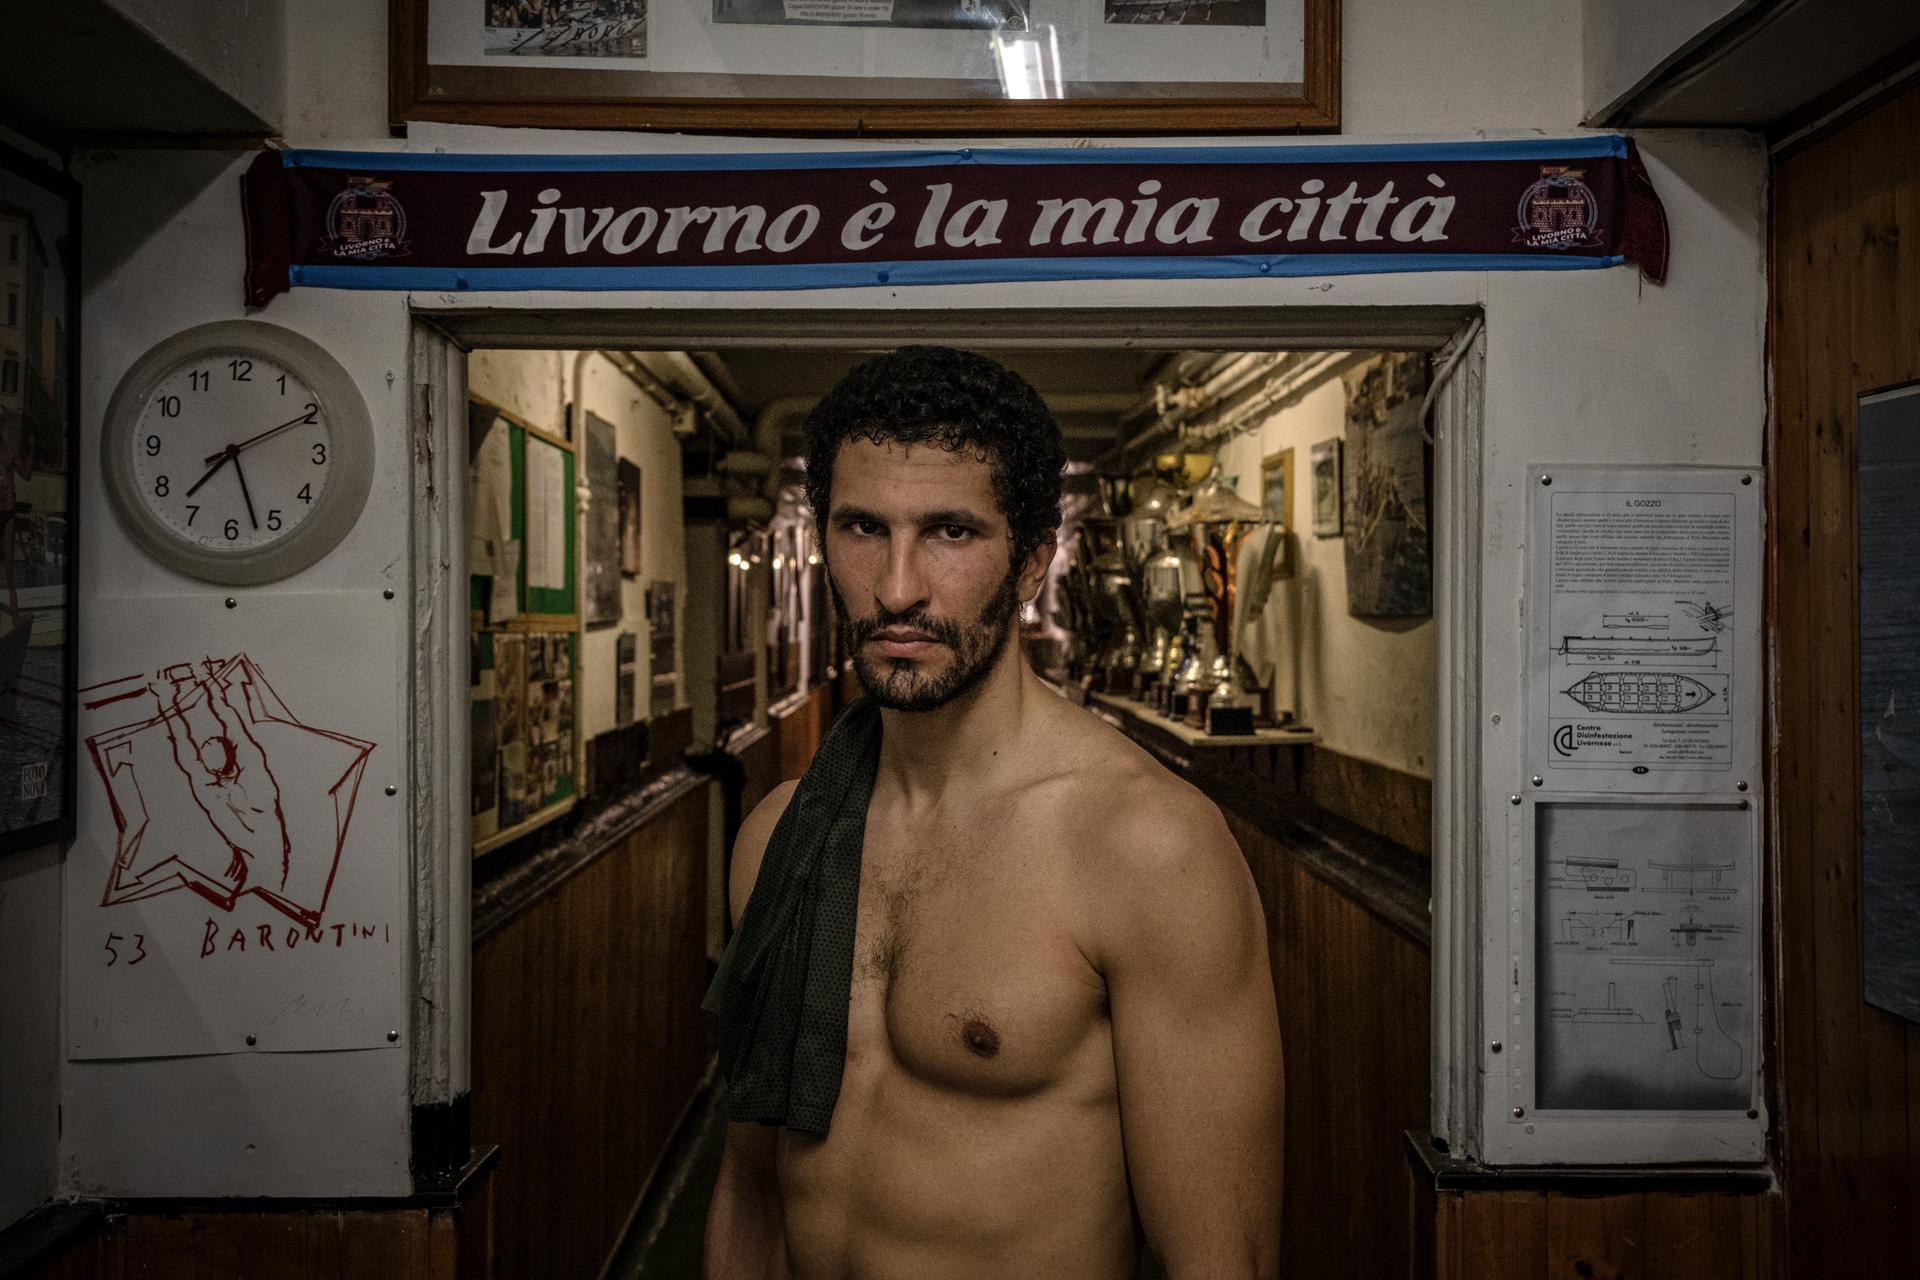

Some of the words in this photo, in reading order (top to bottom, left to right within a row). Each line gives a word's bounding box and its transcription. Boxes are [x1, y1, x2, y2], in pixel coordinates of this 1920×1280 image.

[467, 189, 819, 254] Livorno
[842, 180, 895, 250] è
[915, 183, 1007, 247] la
[1030, 180, 1219, 246] mia
[1240, 174, 1455, 242] città
[339, 238, 383, 251] LIVORNO
[1526, 239, 1539, 247] LA
[1540, 237, 1559, 246] MIA
[1532, 227, 1574, 241] LIVORNO
[333, 249, 346, 257] LA
[348, 247, 367, 256] MIA
[188, 370, 210, 393] 11
[228, 360, 253, 381] 12
[276, 375, 286, 395] 1
[157, 396, 181, 418] 10
[303, 403, 319, 426] 2
[146, 435, 161, 457] 9
[311, 444, 327, 466] 3
[154, 475, 170, 498] 8
[296, 482, 313, 505] 4
[1633, 500, 1662, 508] GOZZO
[185, 505, 200, 527] 7
[266, 509, 282, 532] 5
[223, 519, 239, 541] 6
[1576, 724, 1601, 732] Centro
[1576, 731, 1633, 740] Disinfestazione
[1576, 739, 1612, 747] Livornese
[24, 764, 46, 781] FOTO
[101, 932, 148, 966] 53
[200, 917, 391, 959] BARONTINI
